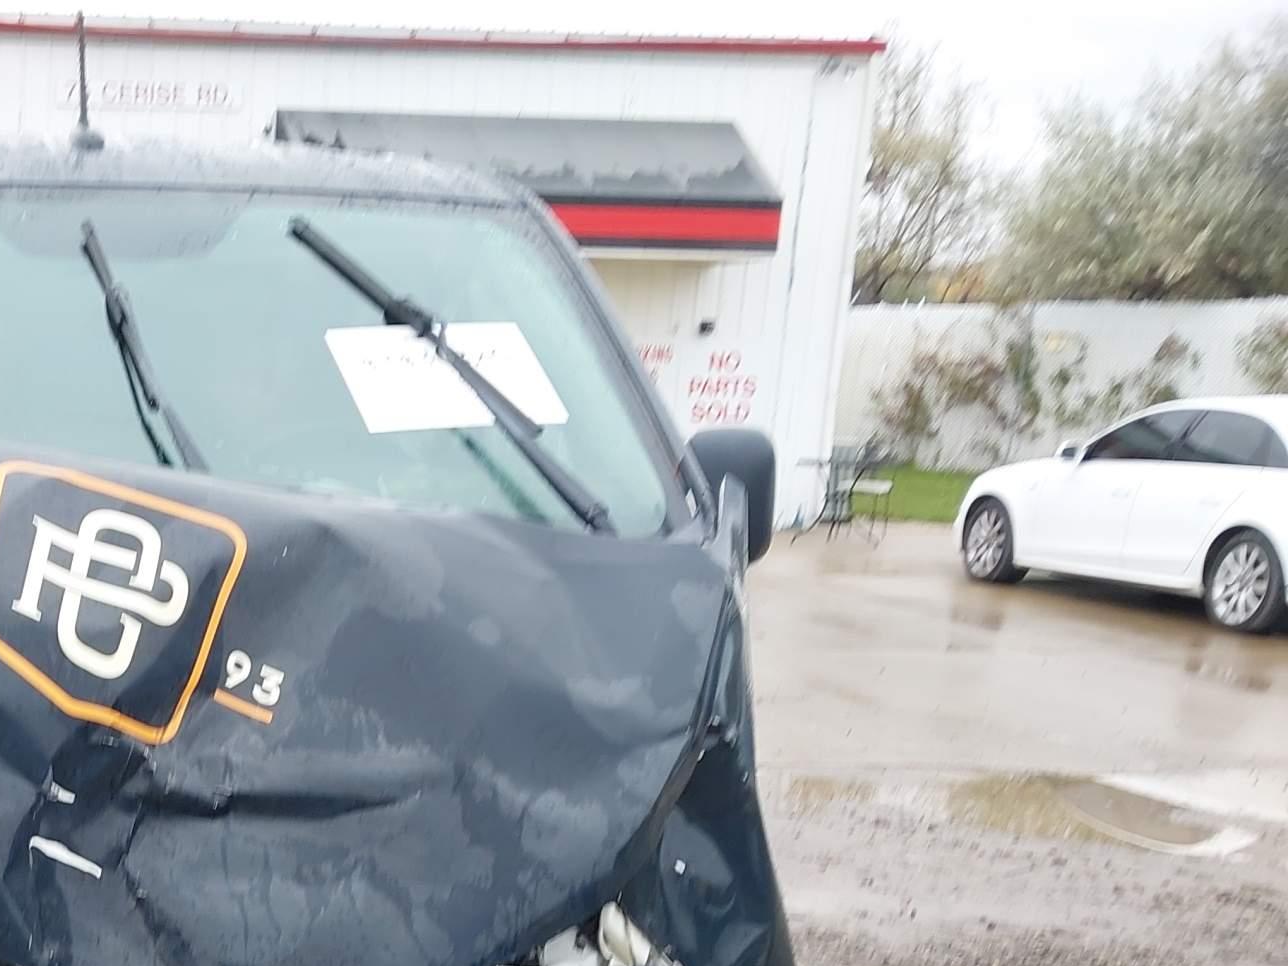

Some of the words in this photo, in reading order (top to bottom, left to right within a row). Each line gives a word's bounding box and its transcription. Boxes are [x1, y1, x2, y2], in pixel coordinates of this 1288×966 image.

[709, 350, 742, 371] NO
[688, 376, 758, 397] PARTS
[691, 401, 752, 423] SOLD
[224, 649, 285, 706] 93
